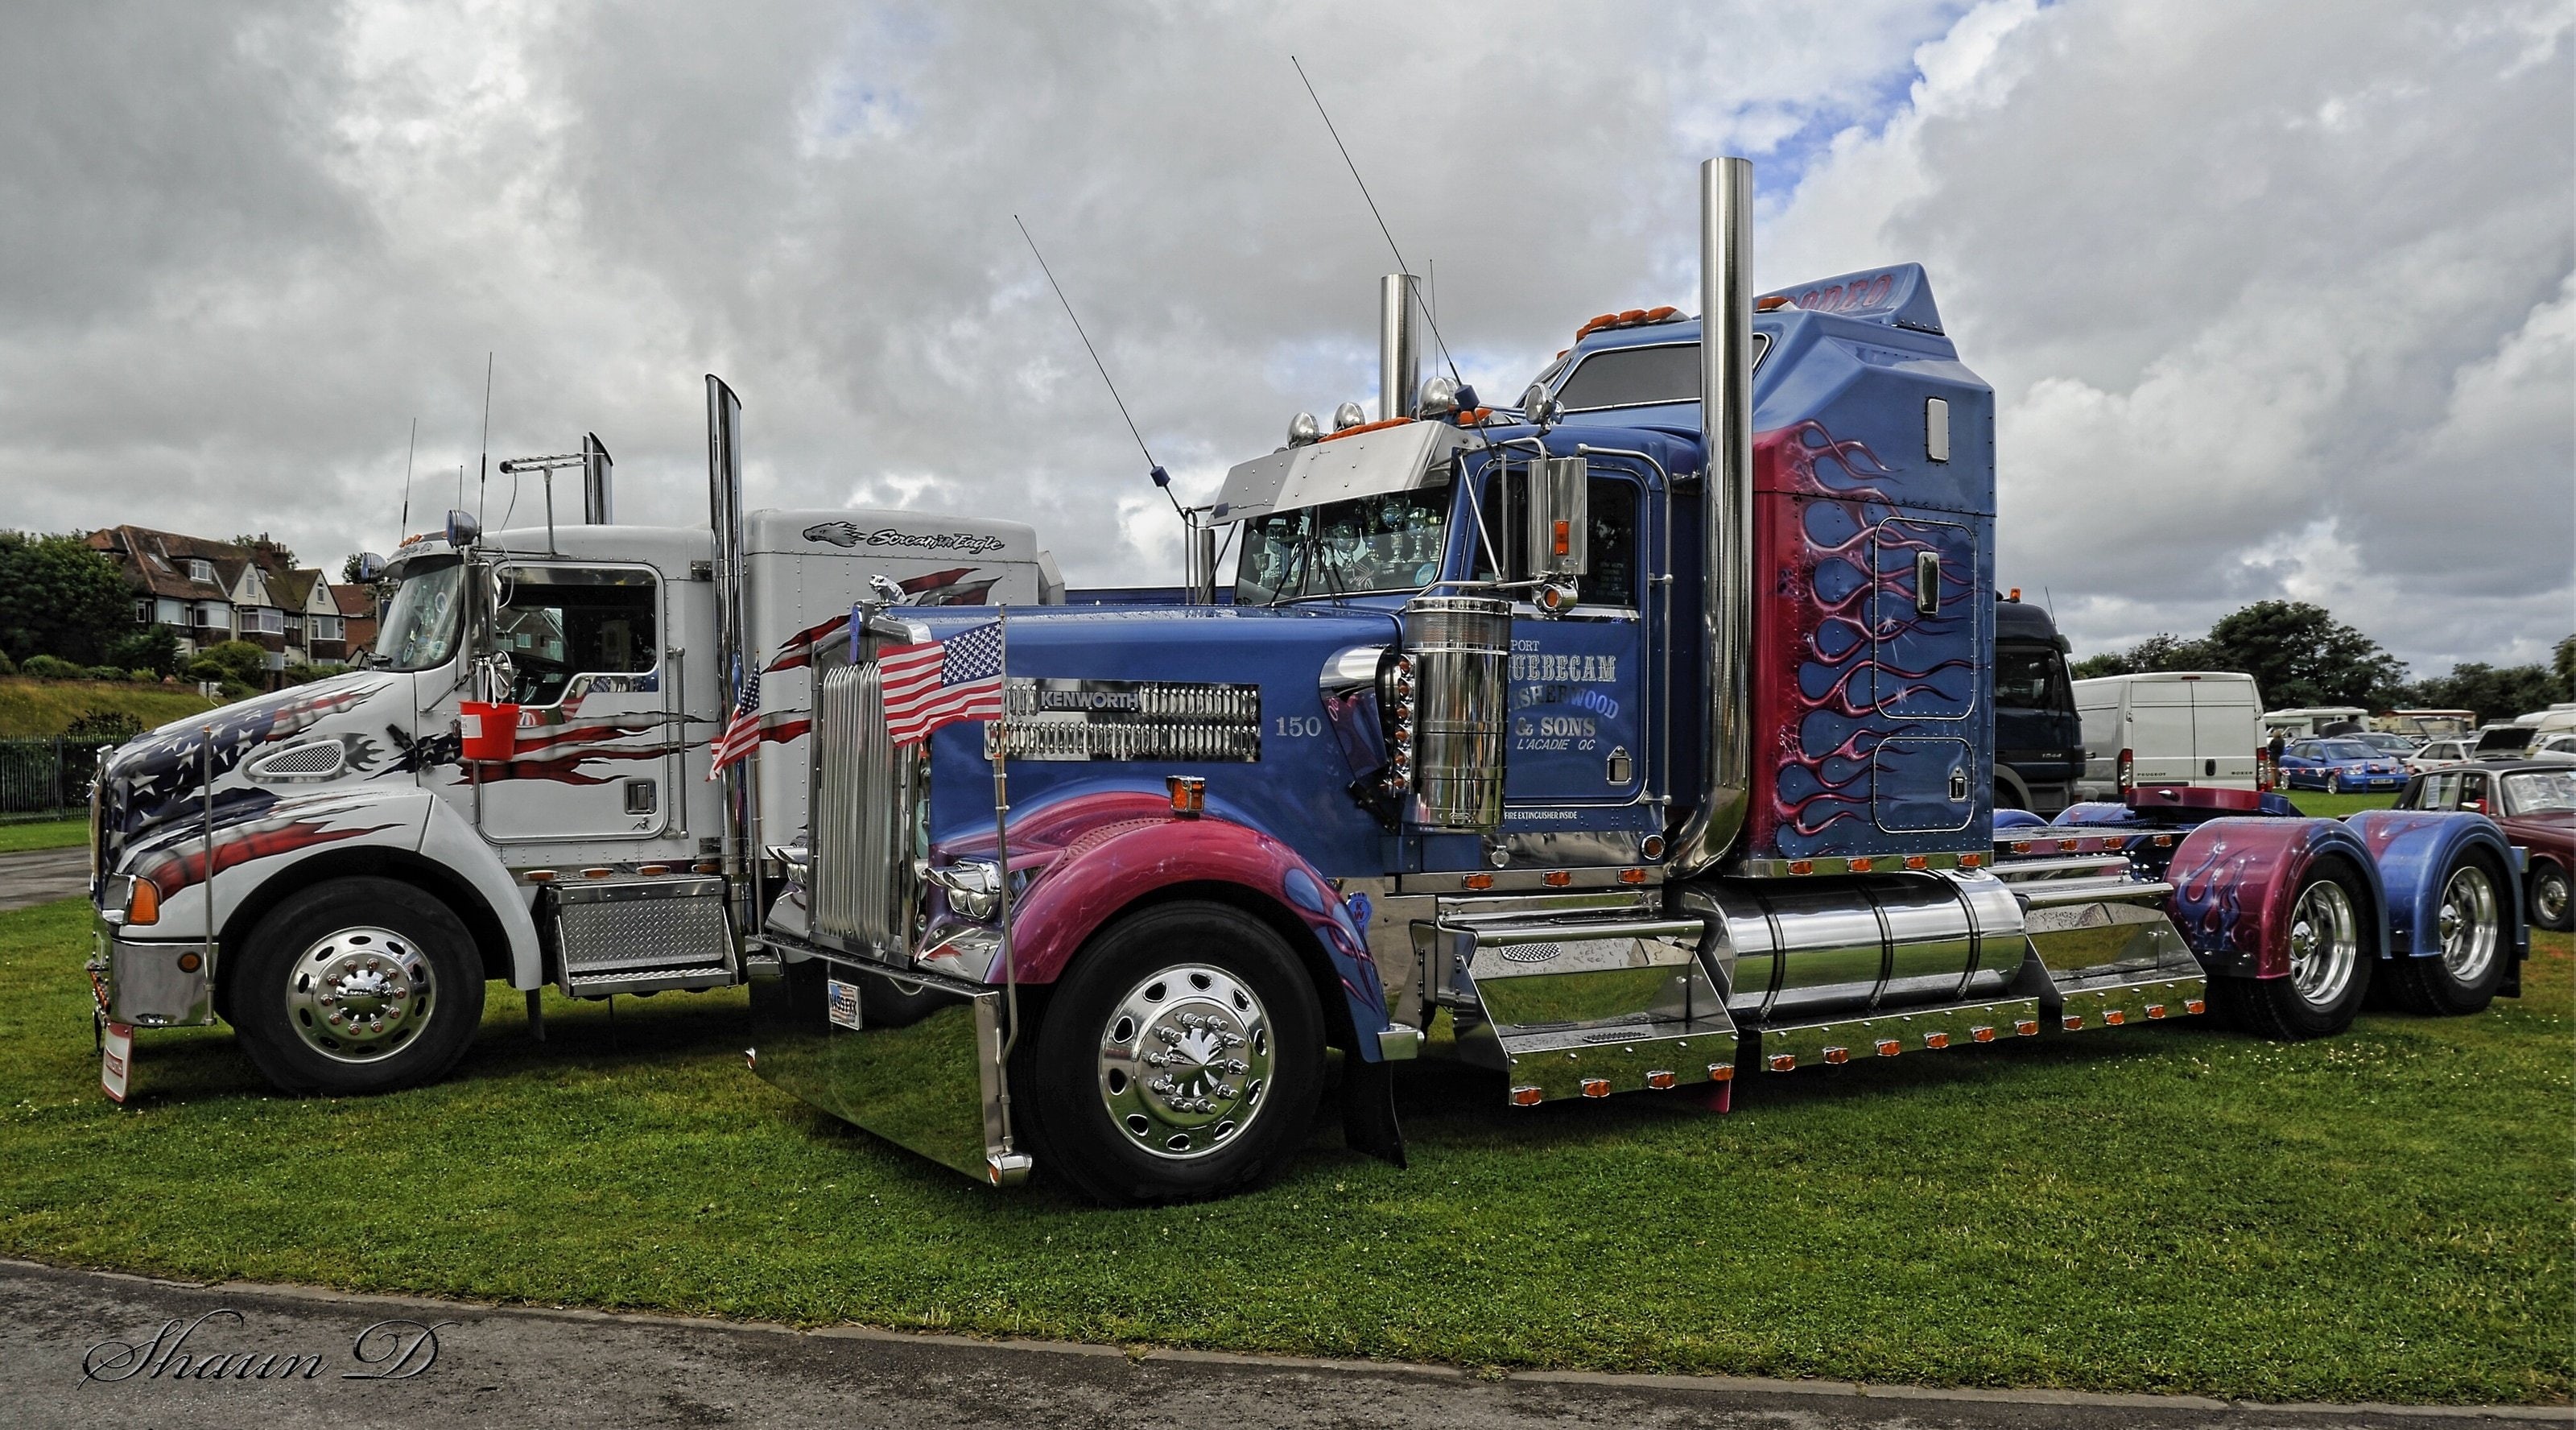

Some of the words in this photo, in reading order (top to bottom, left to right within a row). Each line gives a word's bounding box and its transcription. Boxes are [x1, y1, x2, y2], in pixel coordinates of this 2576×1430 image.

[1508, 654, 1616, 683] UEBECAM
[1041, 692, 1139, 709] KENWORTH
[1276, 716, 1322, 737] 150
[1516, 717, 1534, 736] &
[1541, 717, 1596, 737] SONS
[1517, 738, 1570, 750] L'ACADIE
[1578, 738, 1596, 750] QC
[1505, 811, 1517, 820] FIRE
[1517, 811, 1558, 820] EXTINGUISHER
[1558, 811, 1578, 820] INSIDE
